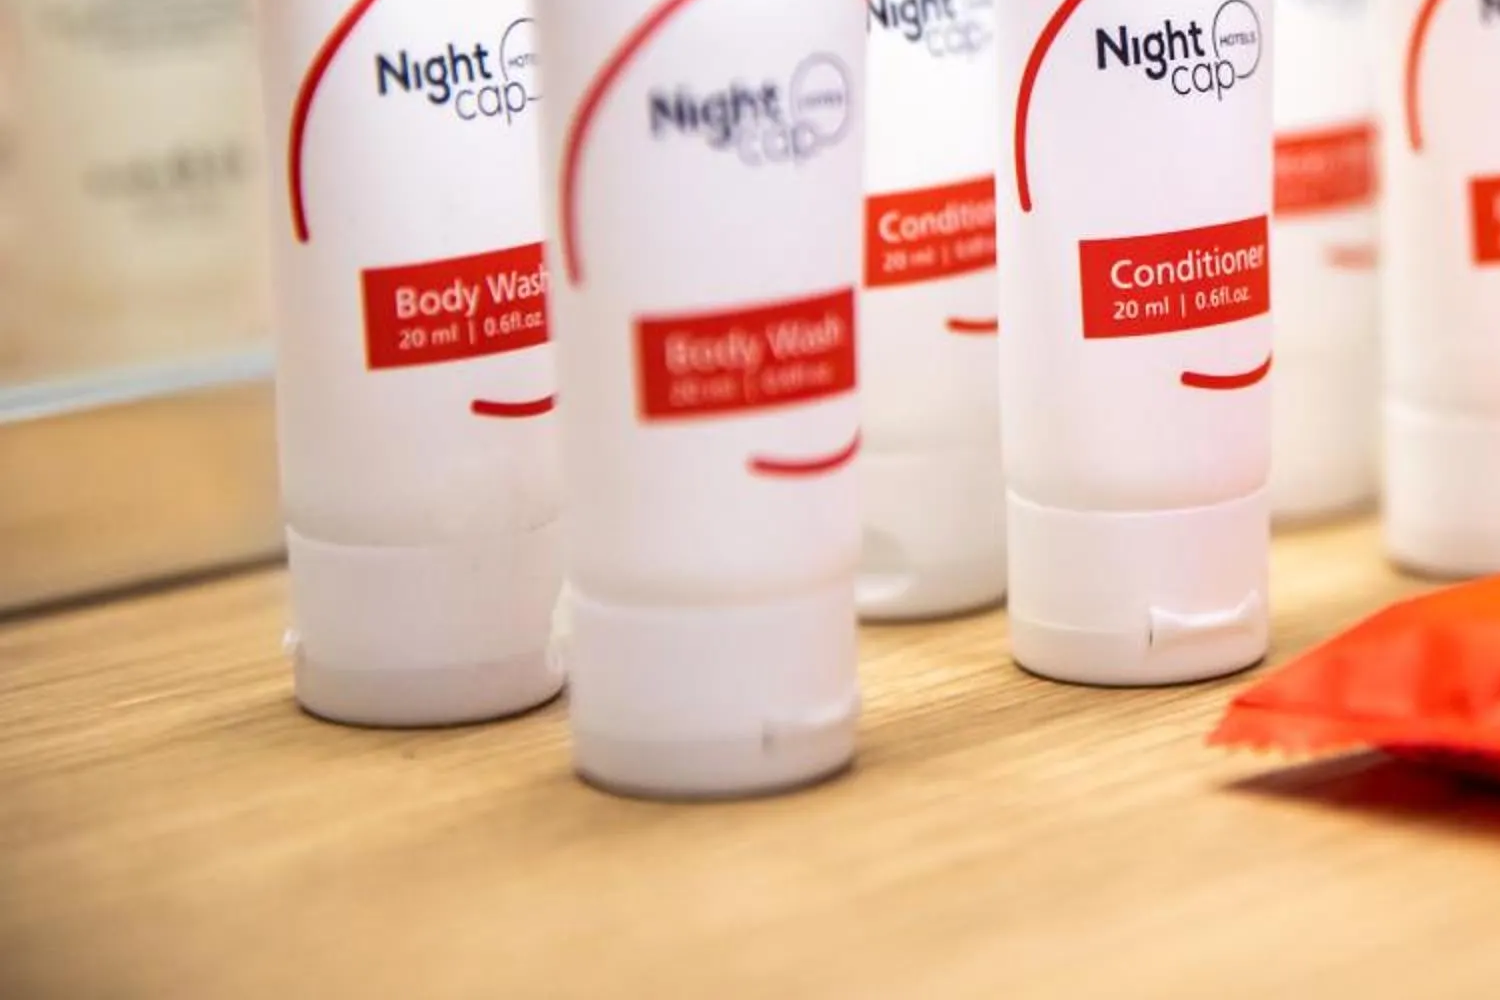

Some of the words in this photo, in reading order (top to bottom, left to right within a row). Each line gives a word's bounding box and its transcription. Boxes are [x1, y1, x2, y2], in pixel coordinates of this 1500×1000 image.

[1095, 19, 1205, 80] Night
[1219, 31, 1255, 47] HOTELS
[375, 43, 493, 104] Night
[1171, 59, 1235, 101] cap
[455, 81, 527, 127] cap
[648, 83, 780, 152] Night
[1110, 244, 1264, 289] Conditioner
[395, 275, 480, 319] Body
[1113, 299, 1139, 320] 20
[1145, 296, 1169, 317] ml
[398, 326, 426, 350] 20
[431, 322, 459, 346] ml
